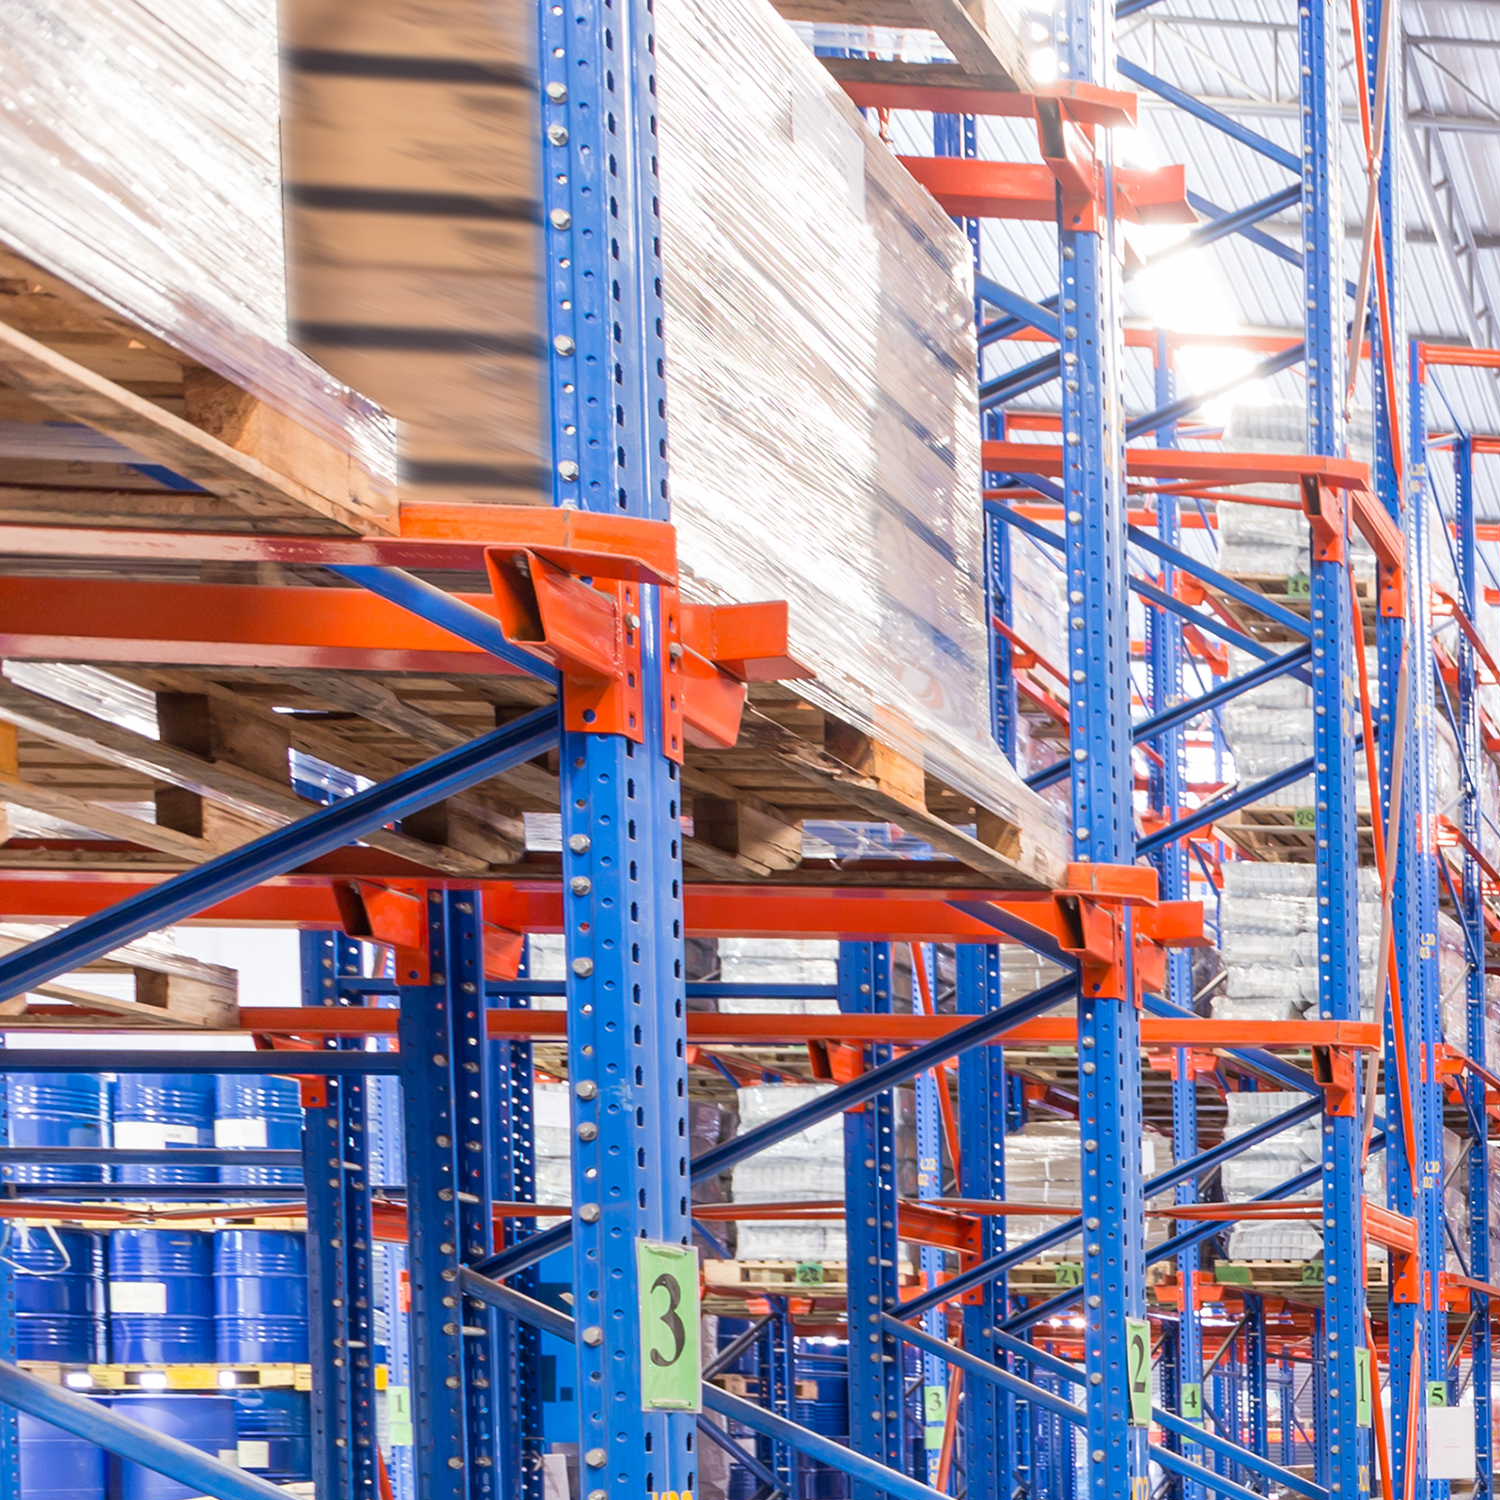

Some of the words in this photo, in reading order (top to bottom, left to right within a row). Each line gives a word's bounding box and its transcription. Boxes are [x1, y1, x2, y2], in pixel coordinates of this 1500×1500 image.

[1057, 1269, 1078, 1285] 21
[650, 1273, 686, 1367] 3
[1132, 1334, 1146, 1393] 2
[1359, 1360, 1366, 1402] 1
[929, 1392, 942, 1411] 3
[1185, 1391, 1197, 1408] 4
[1432, 1387, 1443, 1405] 5
